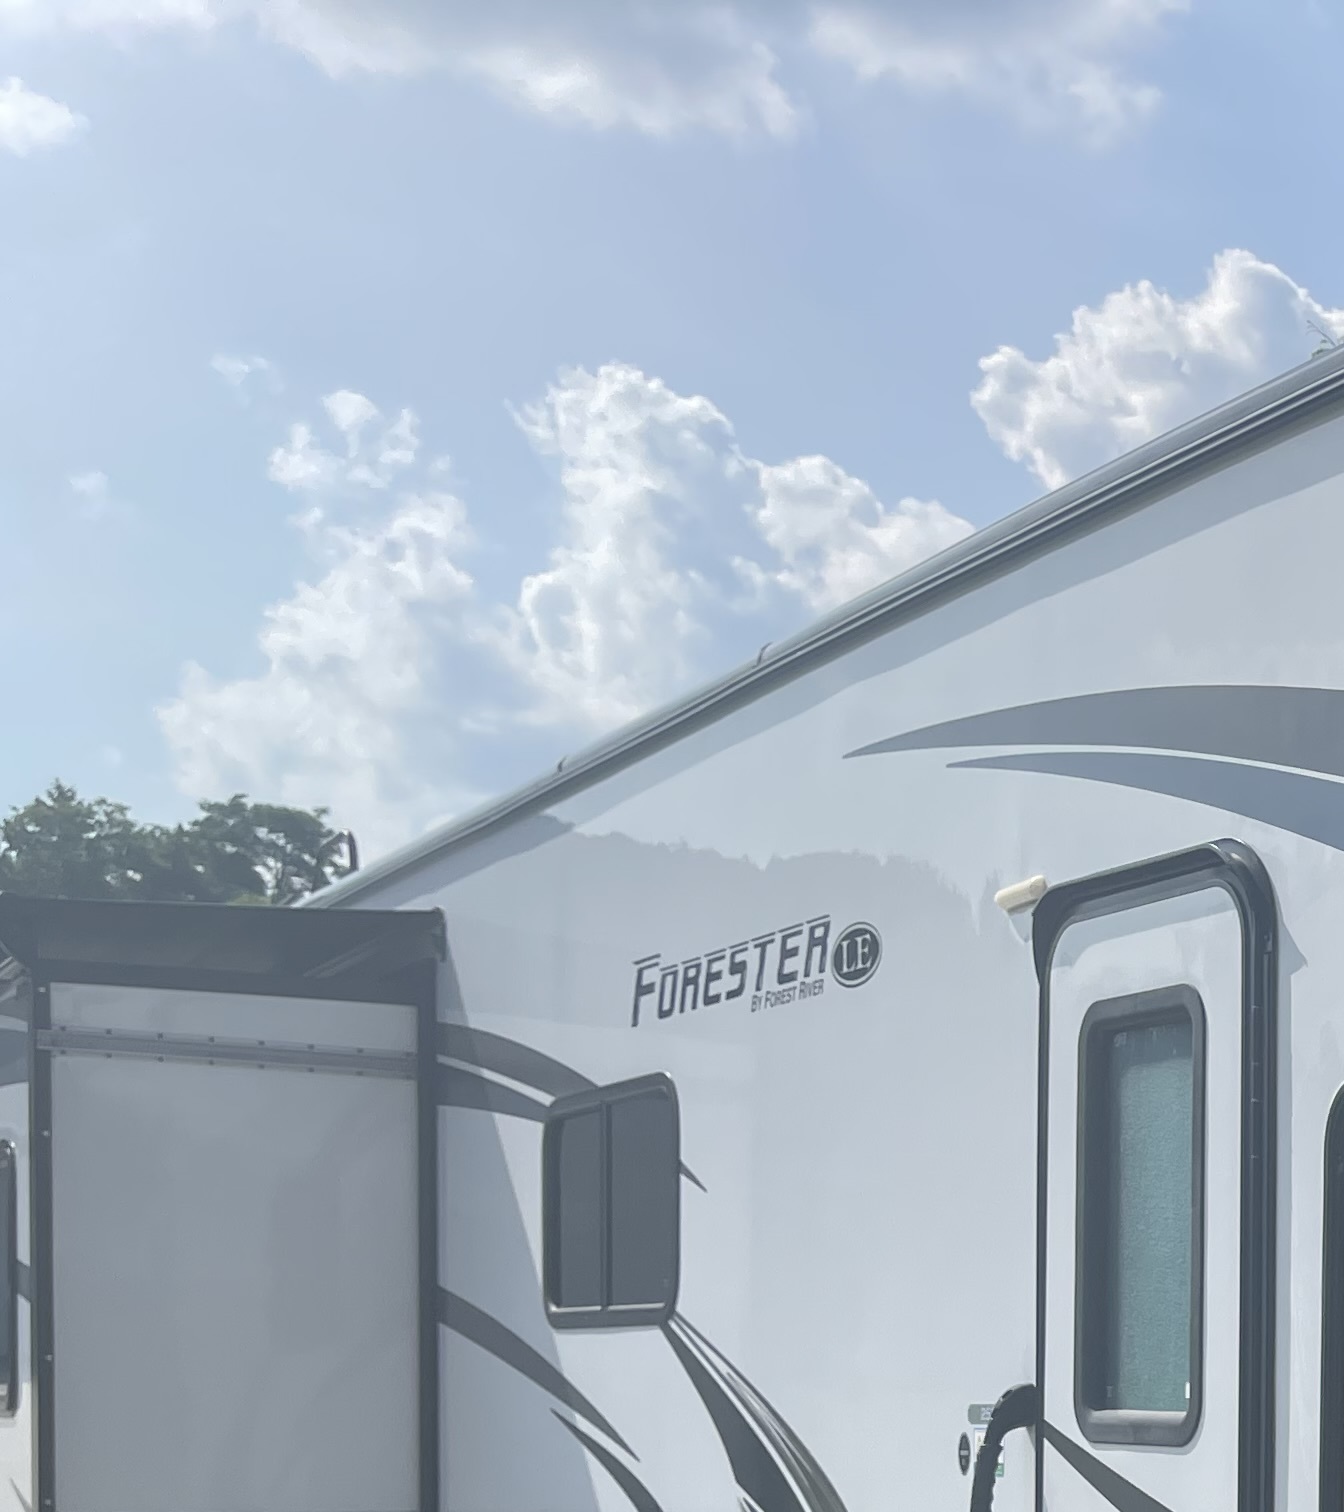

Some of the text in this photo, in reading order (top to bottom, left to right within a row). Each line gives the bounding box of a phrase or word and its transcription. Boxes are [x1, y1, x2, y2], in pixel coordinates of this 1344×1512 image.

[631, 914, 873, 1028] FORESTER LE
[751, 994, 763, 1013] BY
[764, 986, 797, 1009] FOREST
